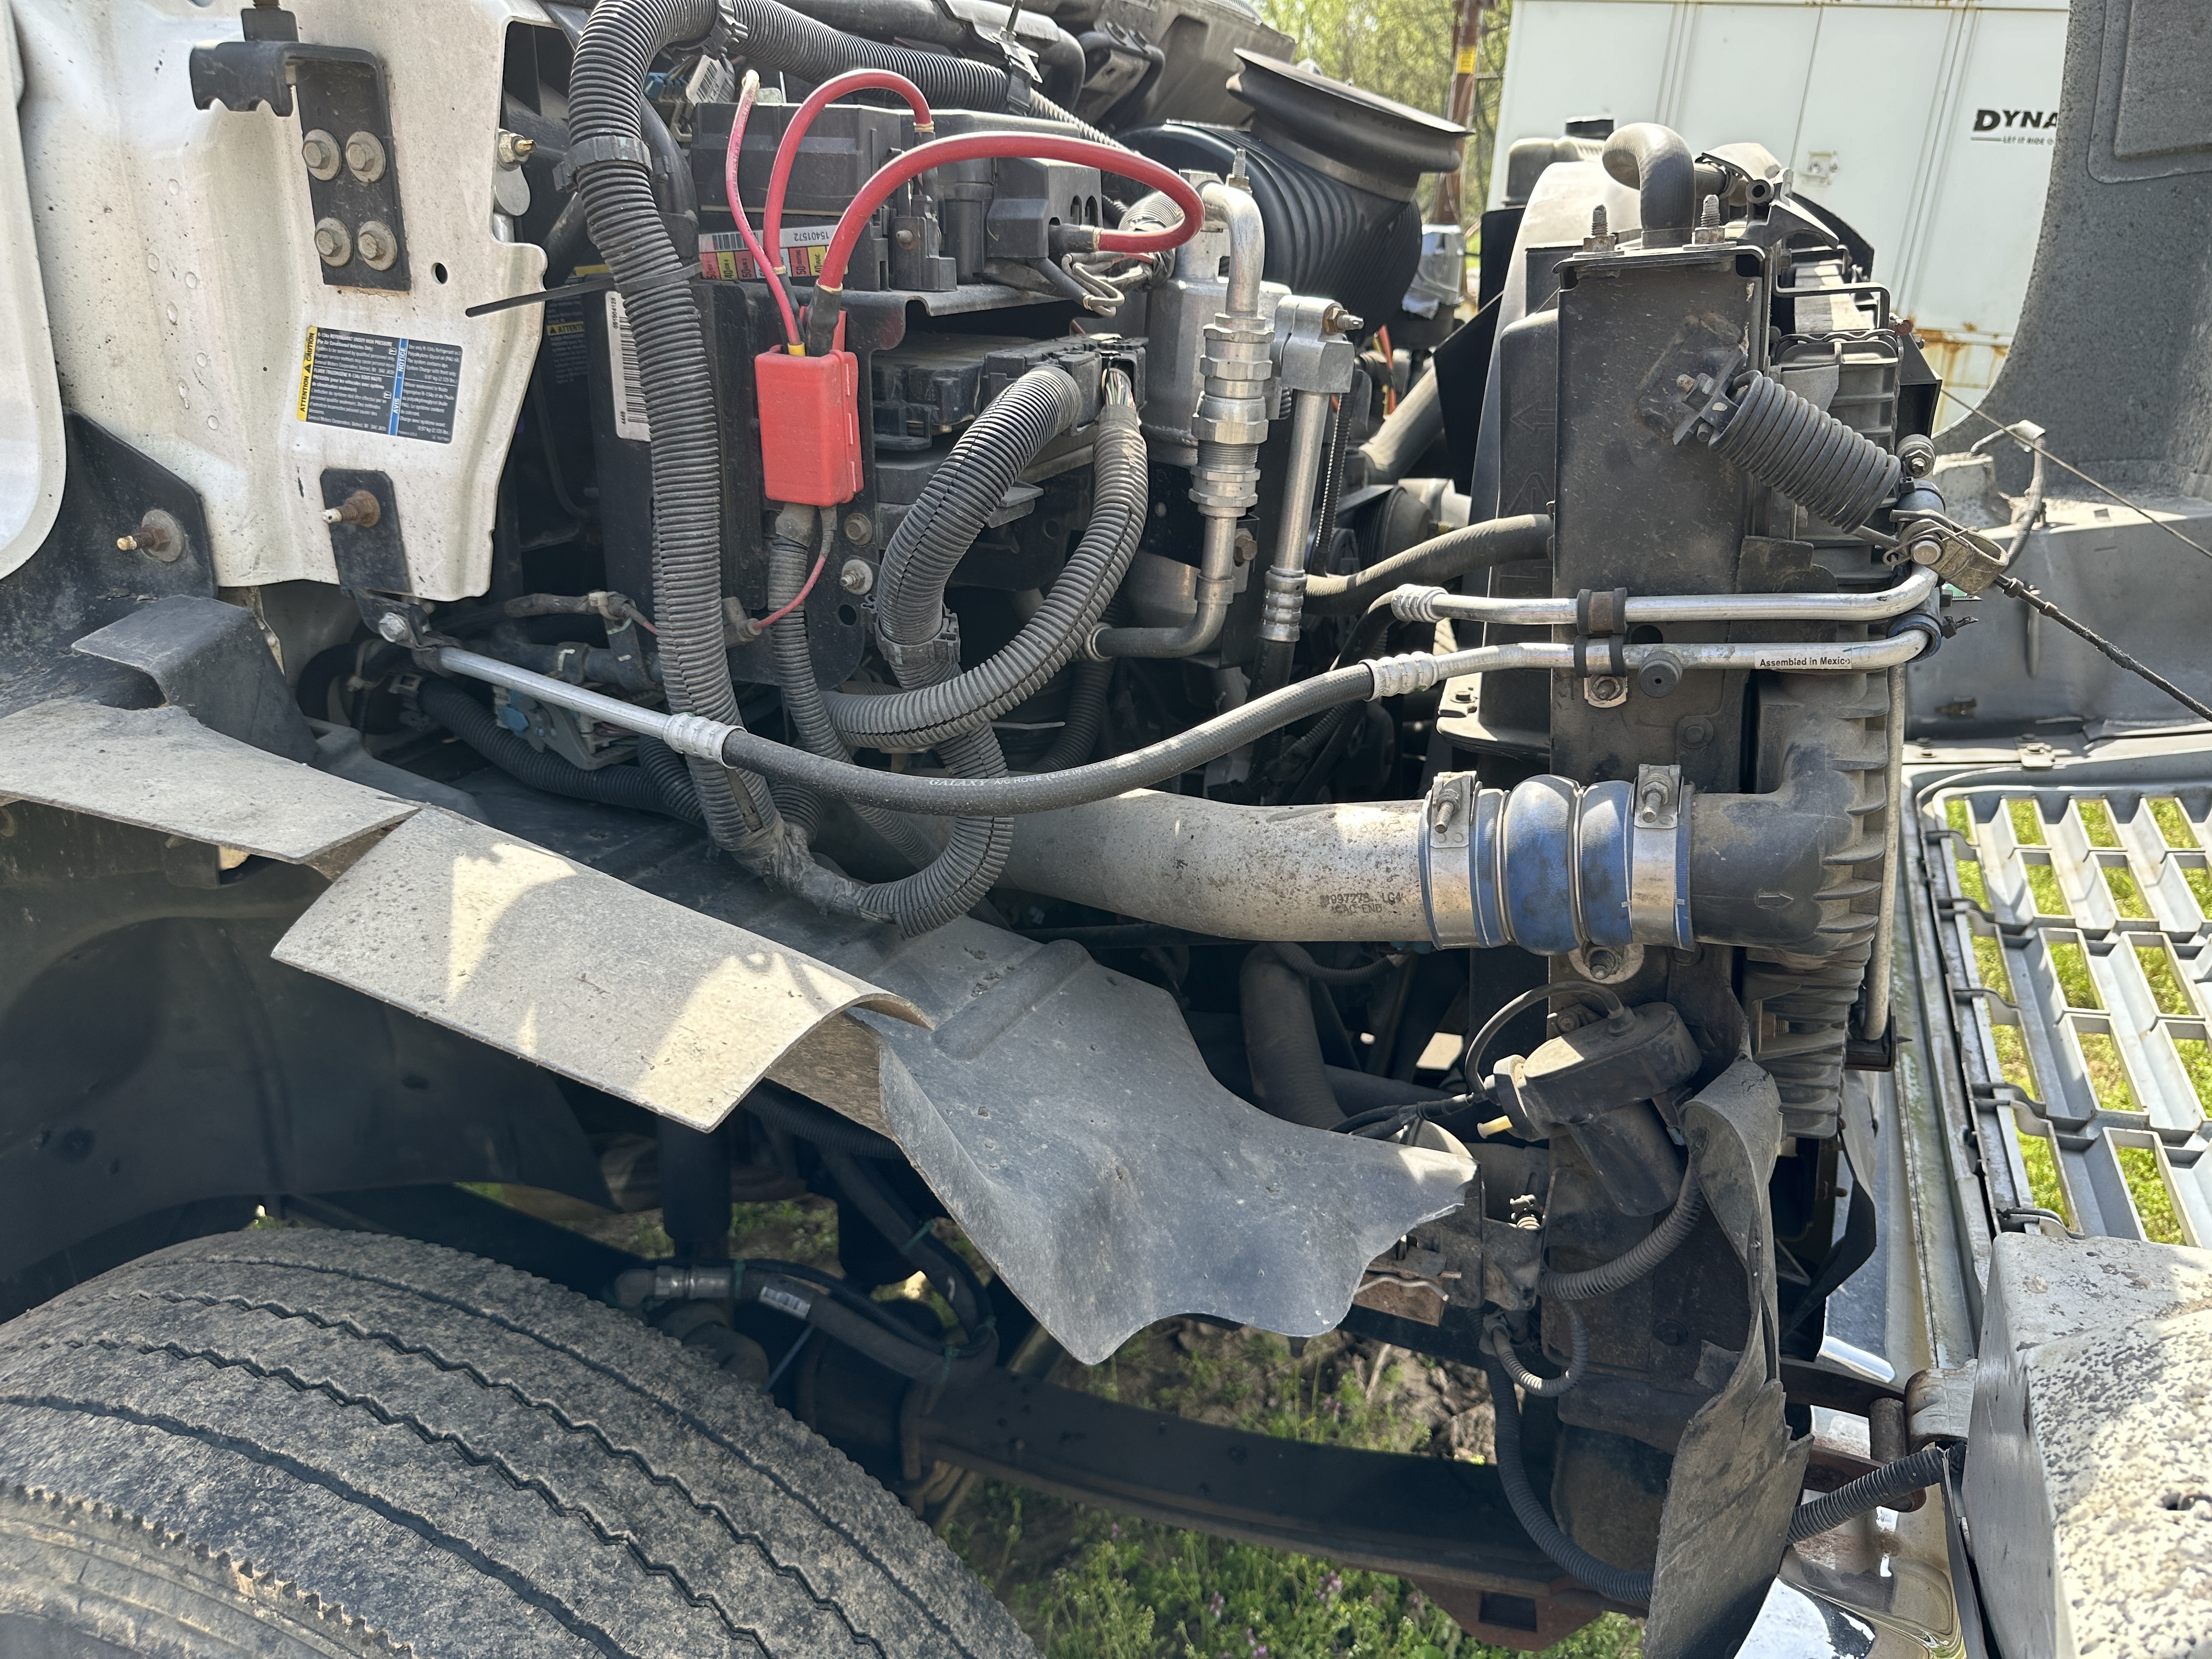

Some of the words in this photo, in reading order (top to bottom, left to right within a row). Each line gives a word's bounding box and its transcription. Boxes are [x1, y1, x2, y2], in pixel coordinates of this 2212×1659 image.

[794, 231, 829, 241] 15401572
[741, 269, 752, 278] 50
[796, 266, 806, 275] 50
[301, 376, 309, 411] ATTENTION
[1810, 657, 1817, 665] in
[1046, 771, 1070, 782] 13/32
[1362, 904, 1383, 913] END
